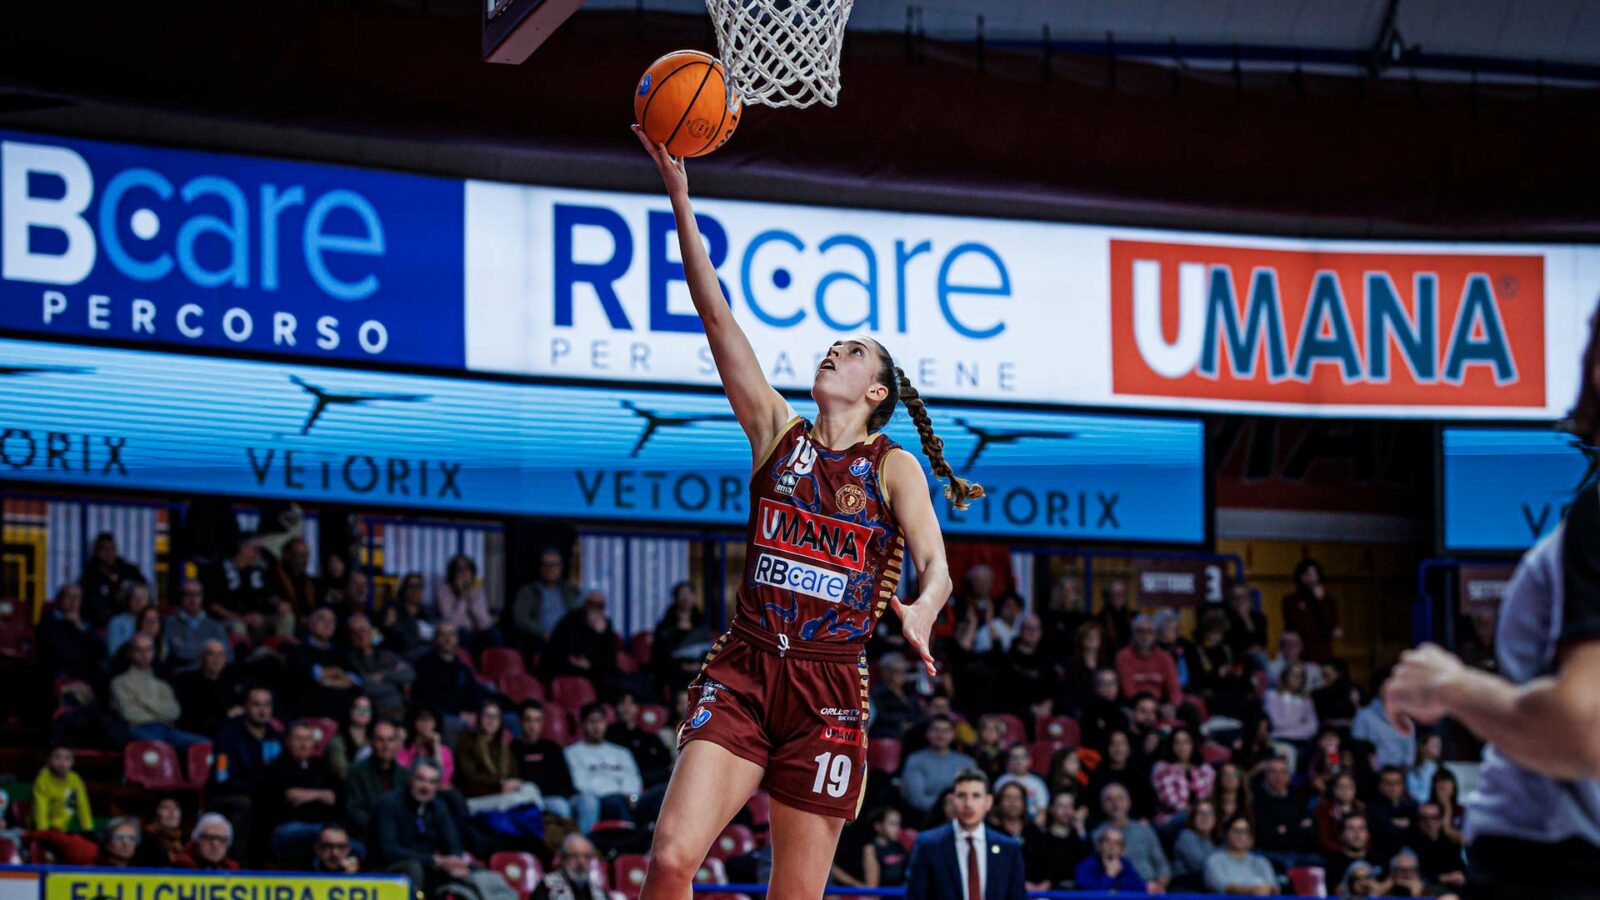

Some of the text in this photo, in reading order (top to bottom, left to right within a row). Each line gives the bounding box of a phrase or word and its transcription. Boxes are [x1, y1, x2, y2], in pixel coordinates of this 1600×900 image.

[553, 203, 1012, 340] RBcare
[43, 291, 389, 353] PERCORSO
[1131, 258, 1519, 388] UMANA
[551, 338, 1017, 391] PER SA ENE
[246, 446, 463, 499] VETORIX
[786, 435, 818, 475] 19
[574, 469, 743, 512] VETOR
[931, 484, 1121, 529] TORIX
[762, 506, 860, 563] UMANA
[756, 556, 844, 598] RBcare
[1204, 565, 1223, 602] 3
[812, 751, 852, 798] 19
